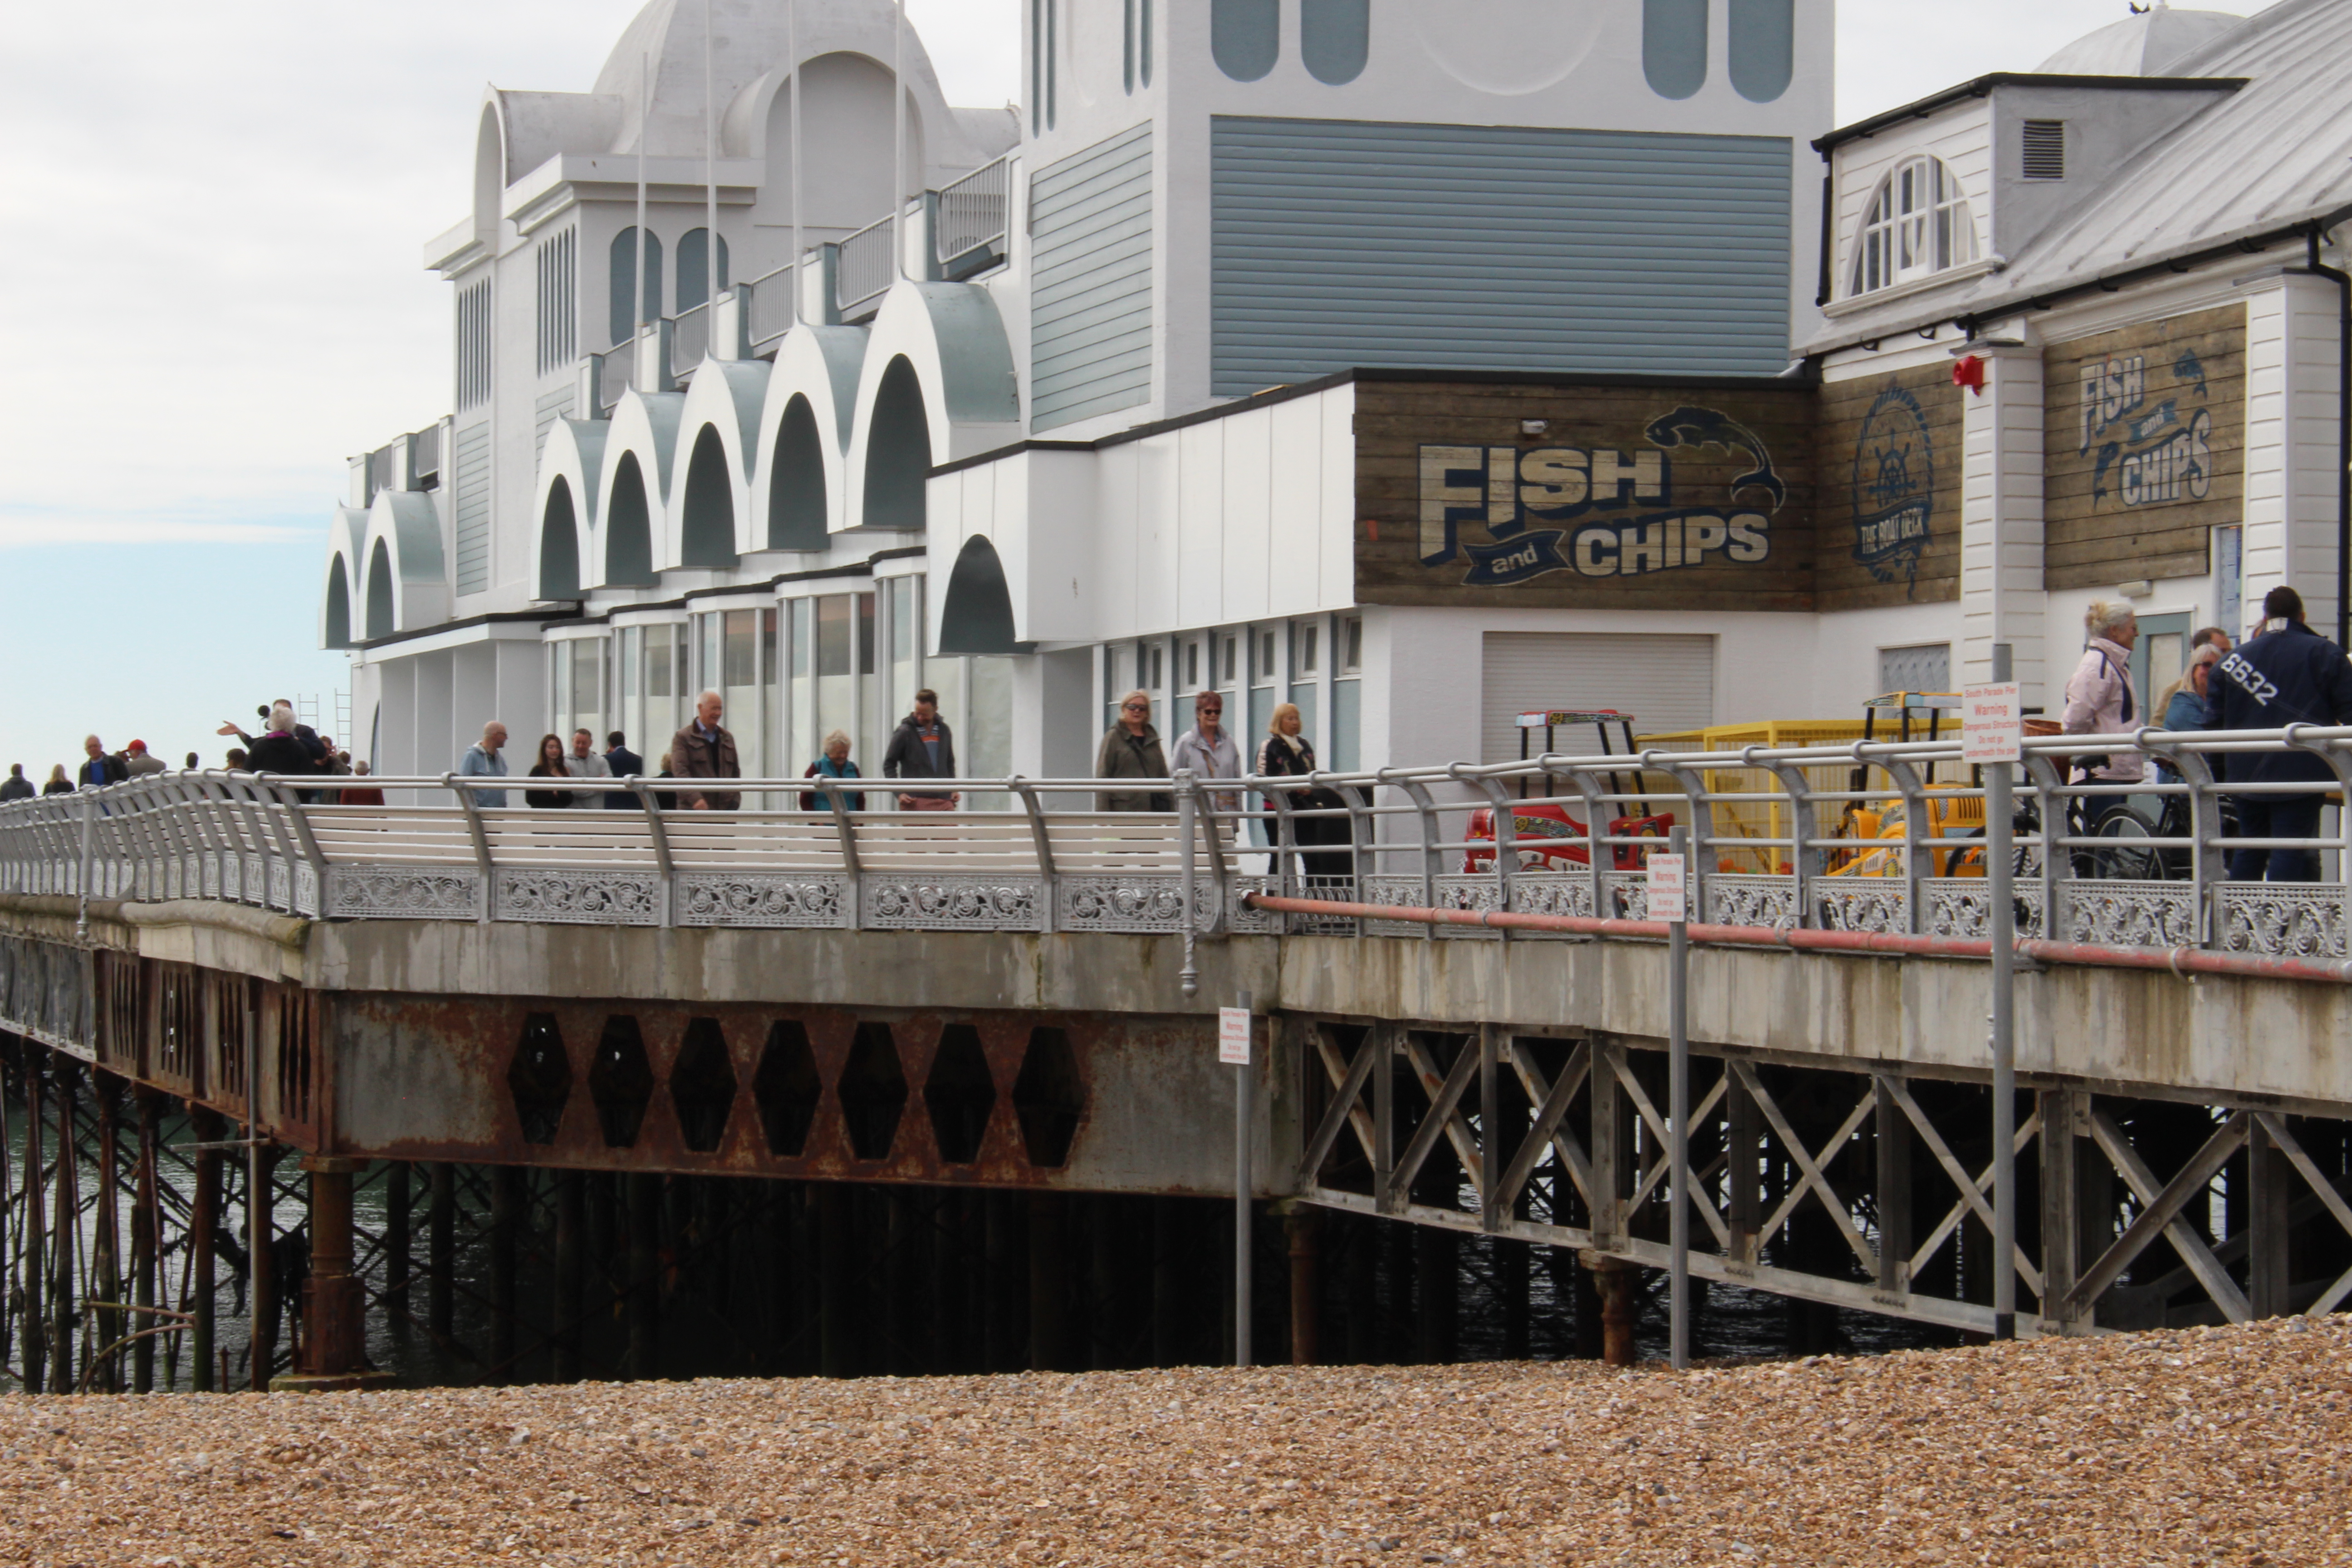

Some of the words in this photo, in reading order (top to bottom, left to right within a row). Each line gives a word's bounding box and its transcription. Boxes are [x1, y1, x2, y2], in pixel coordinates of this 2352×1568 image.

[2079, 356, 2143, 450] FISH
[2140, 406, 2165, 437] and
[2121, 412, 2210, 505] CHIPS
[1419, 445, 1664, 561] FISH
[1861, 524, 1877, 554] THE
[1878, 513, 1900, 550] BOAT
[1901, 507, 1925, 539] DECK
[1491, 542, 1539, 574] and
[1575, 513, 1769, 576] CHIPS
[2220, 652, 2279, 706] 6632
[1965, 690, 1982, 698] South
[1984, 688, 2003, 696] Parade
[2005, 686, 2017, 694] Pier
[1975, 703, 2008, 716] Warning
[1964, 722, 1991, 732] Dangerous
[1992, 720, 2019, 729] Structure
[1978, 735, 1986, 744] Do
[1997, 736, 2004, 745] go
[1965, 748, 1995, 757] underneath
[2006, 747, 2017, 755] pier
[1655, 871, 1677, 883] Warning
[1226, 1021, 1244, 1033] Warning
